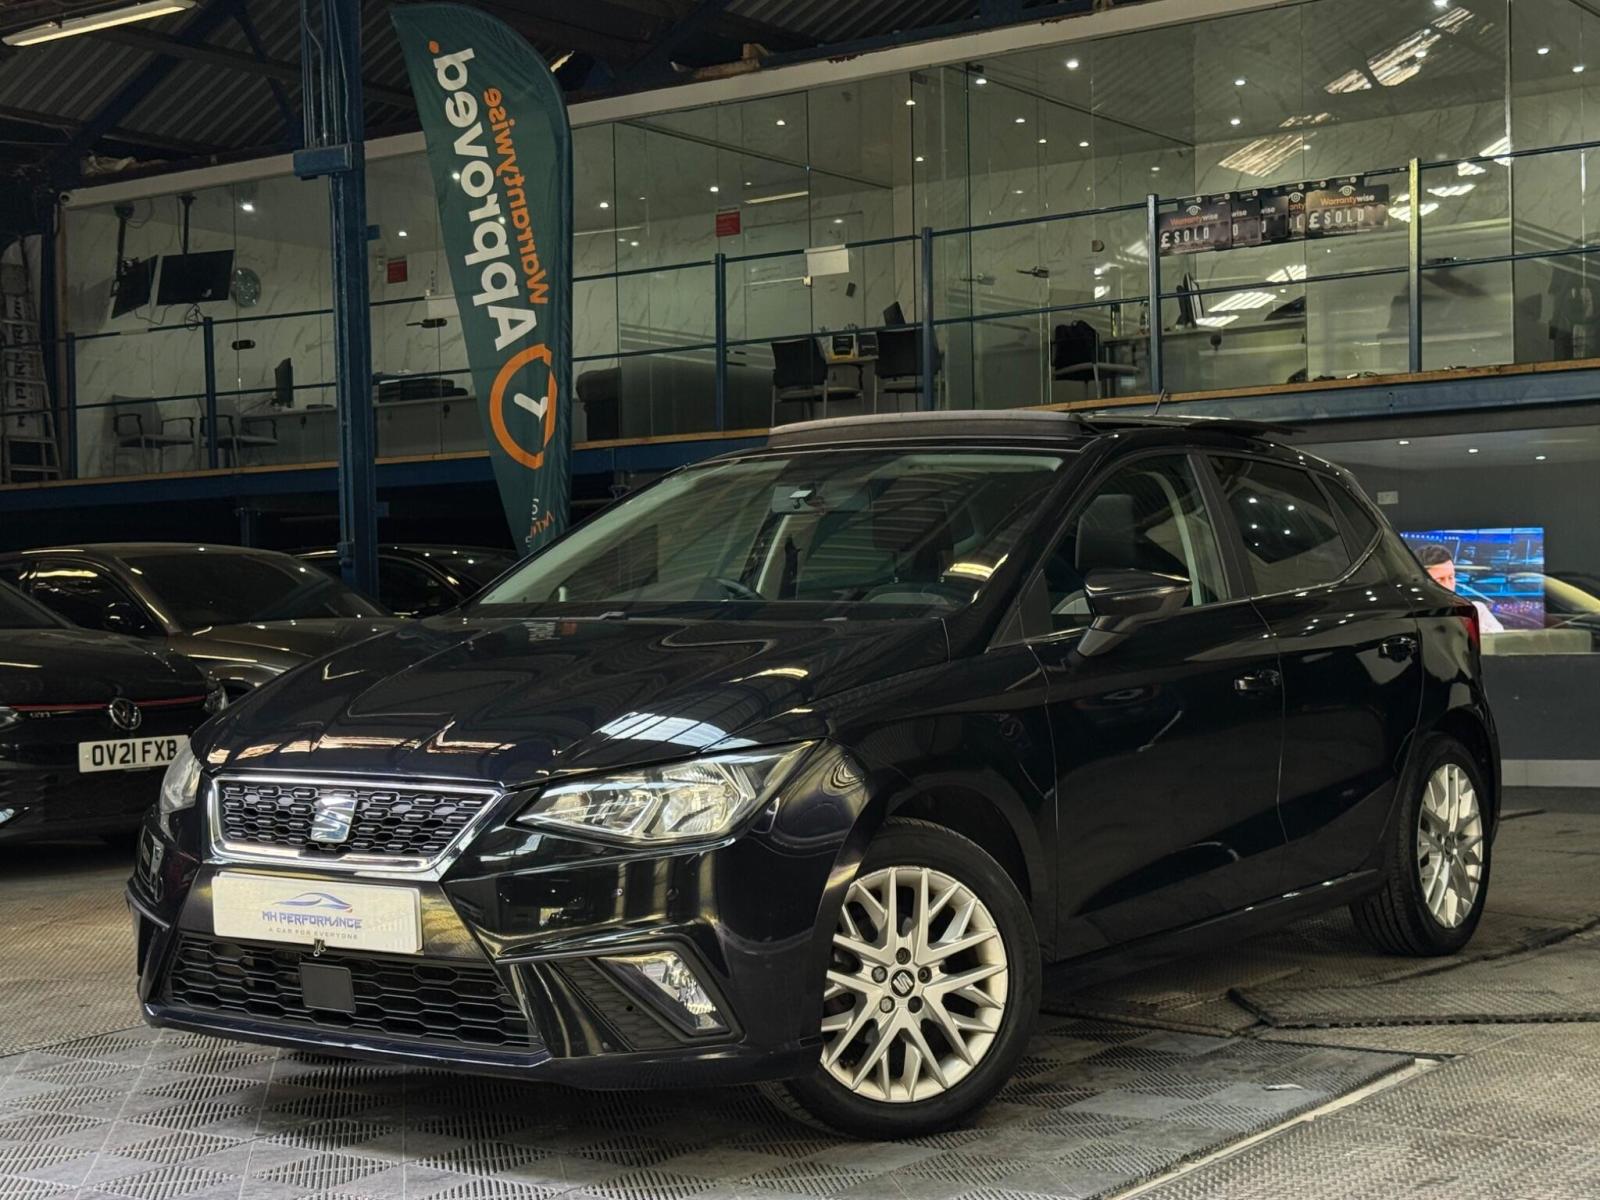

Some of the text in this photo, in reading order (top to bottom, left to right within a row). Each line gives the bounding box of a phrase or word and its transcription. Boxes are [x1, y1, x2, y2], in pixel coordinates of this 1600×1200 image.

[1319, 193, 1375, 206] Warrantywise
[1169, 213, 1219, 226] Warrantywise
[92, 739, 177, 766] OV21 FXB
[280, 913, 362, 929] PERFORMANCE
[314, 931, 358, 939] EVERYONE
